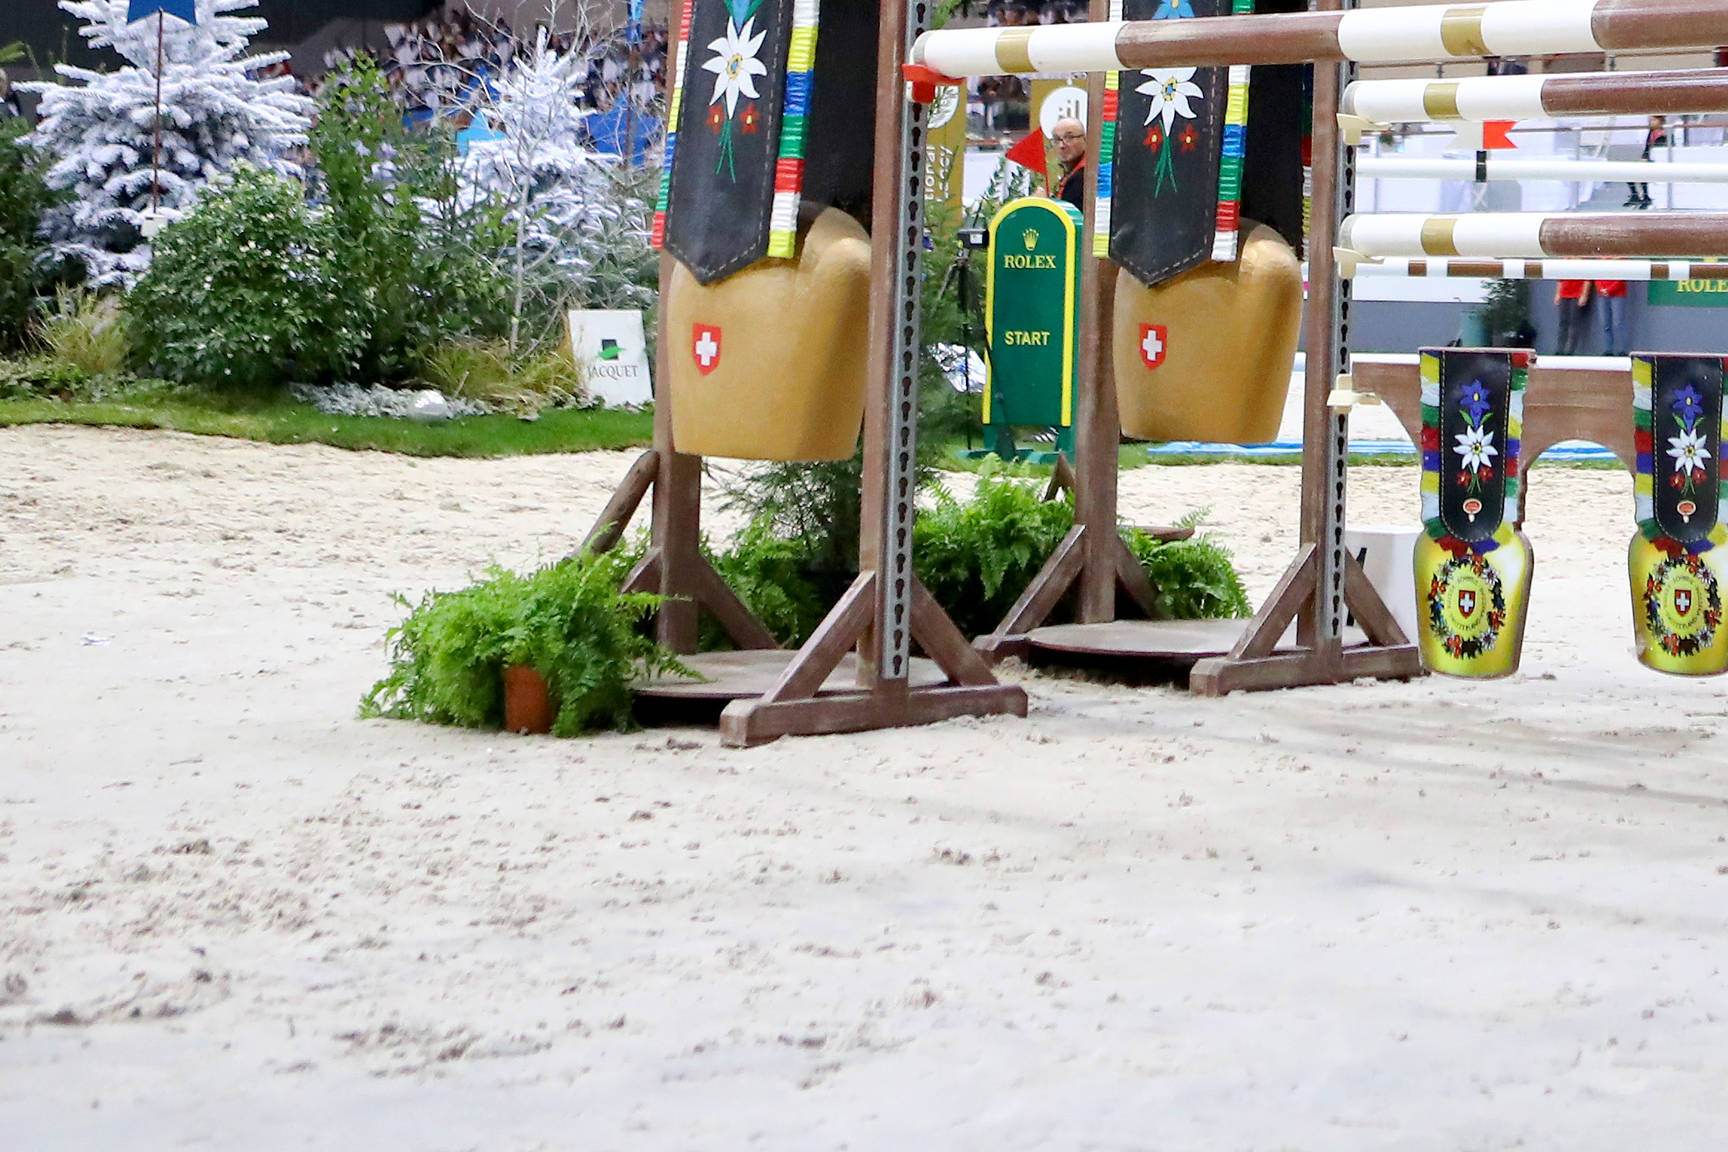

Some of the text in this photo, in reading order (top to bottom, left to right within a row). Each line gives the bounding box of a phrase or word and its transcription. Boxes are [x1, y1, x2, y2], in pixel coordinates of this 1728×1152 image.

[1004, 255, 1056, 269] ROLEX
[1004, 331, 1050, 346] START
[587, 365, 639, 380] JACQUET
